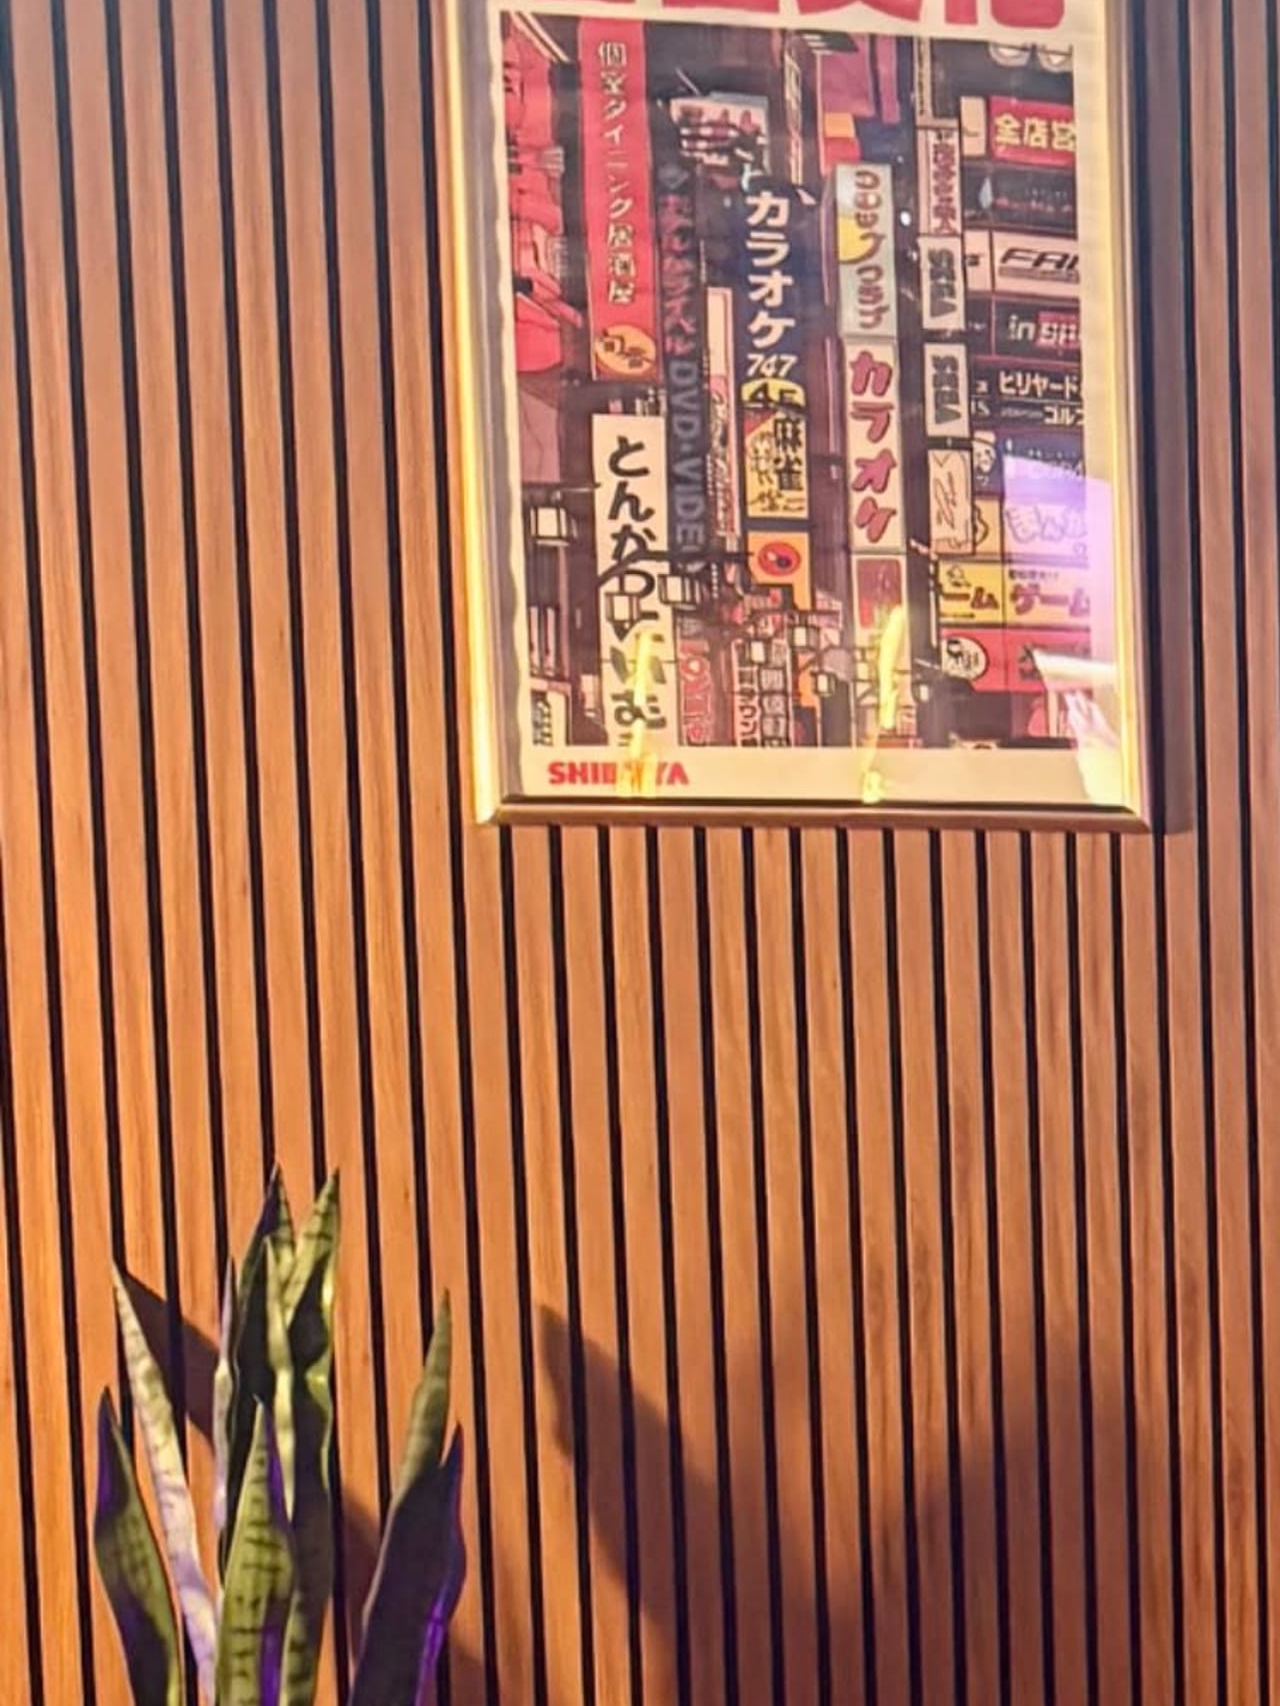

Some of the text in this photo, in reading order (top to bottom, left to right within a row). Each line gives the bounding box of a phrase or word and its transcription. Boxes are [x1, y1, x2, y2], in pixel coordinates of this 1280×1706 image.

[745, 191, 797, 349] カラオケ
[745, 352, 798, 378] 747
[850, 351, 900, 544] カラオケ
[548, 761, 689, 786] SHIBA
